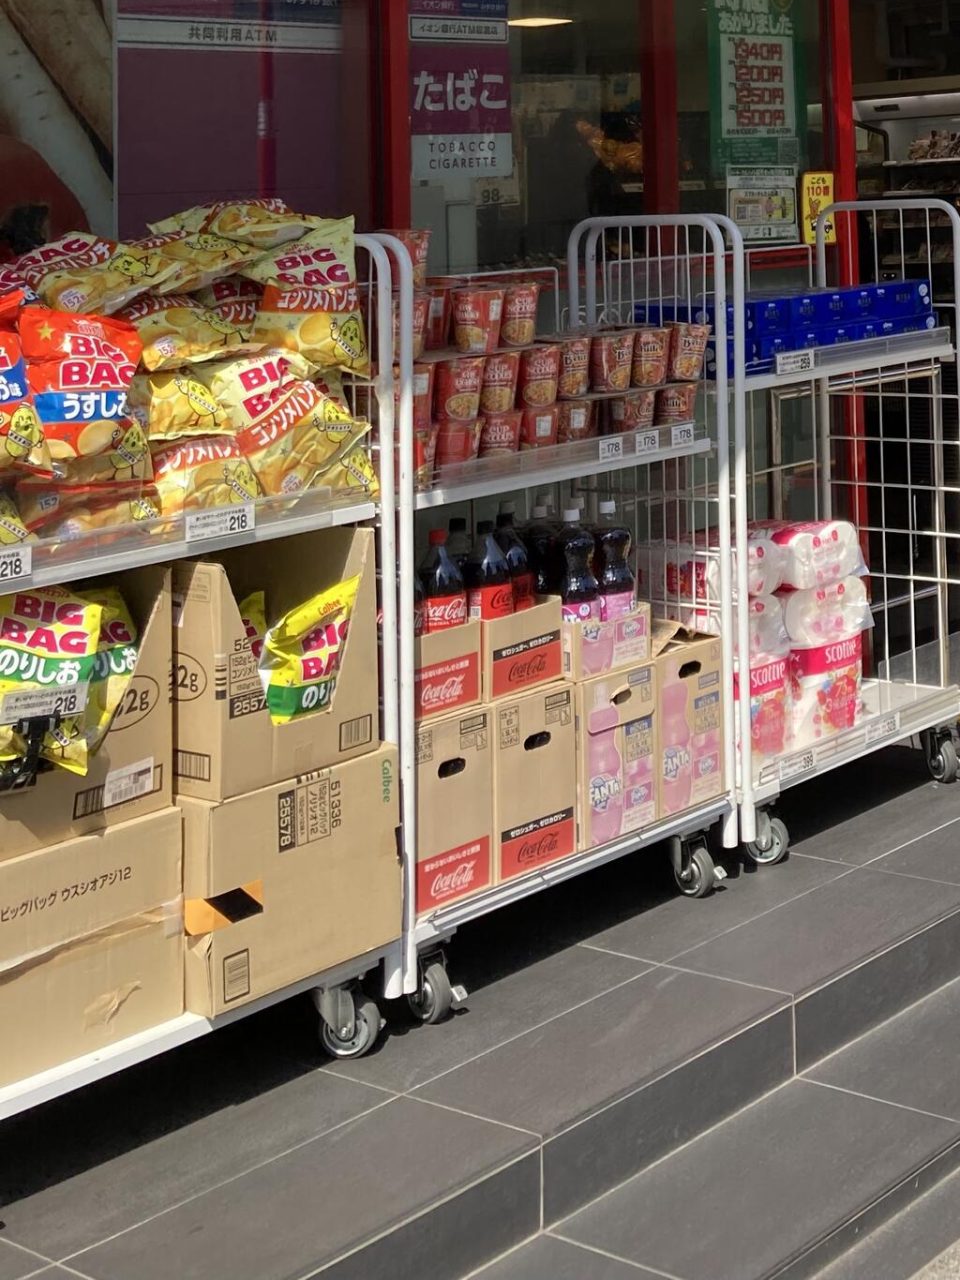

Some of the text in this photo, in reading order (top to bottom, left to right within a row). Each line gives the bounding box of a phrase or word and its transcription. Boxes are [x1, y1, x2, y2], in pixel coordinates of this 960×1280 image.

[718, 11, 794, 36] あがりました
[412, 68, 508, 113] たばこ
[428, 141, 497, 154] TOBACCO
[428, 156, 498, 170] CIGARETTE
[274, 248, 337, 271] BIG
[275, 264, 349, 288] BAG
[69, 334, 127, 364] BIG
[643, 436, 656, 446] 178
[680, 428, 692, 439] 178
[606, 443, 621, 453] 178
[229, 514, 249, 532] 218
[0, 558, 22, 579] 218
[14, 594, 85, 627] BIG
[317, 597, 342, 617] Calbee
[1, 617, 89, 655] BAG
[0, 649, 82, 685] のりしお
[54, 695, 77, 715] 218
[382, 759, 393, 804] Calbee
[330, 780, 342, 829] 51336
[279, 797, 292, 847] 25578
[0, 866, 132, 923] ビッグバッグ ウスシオアジ12
